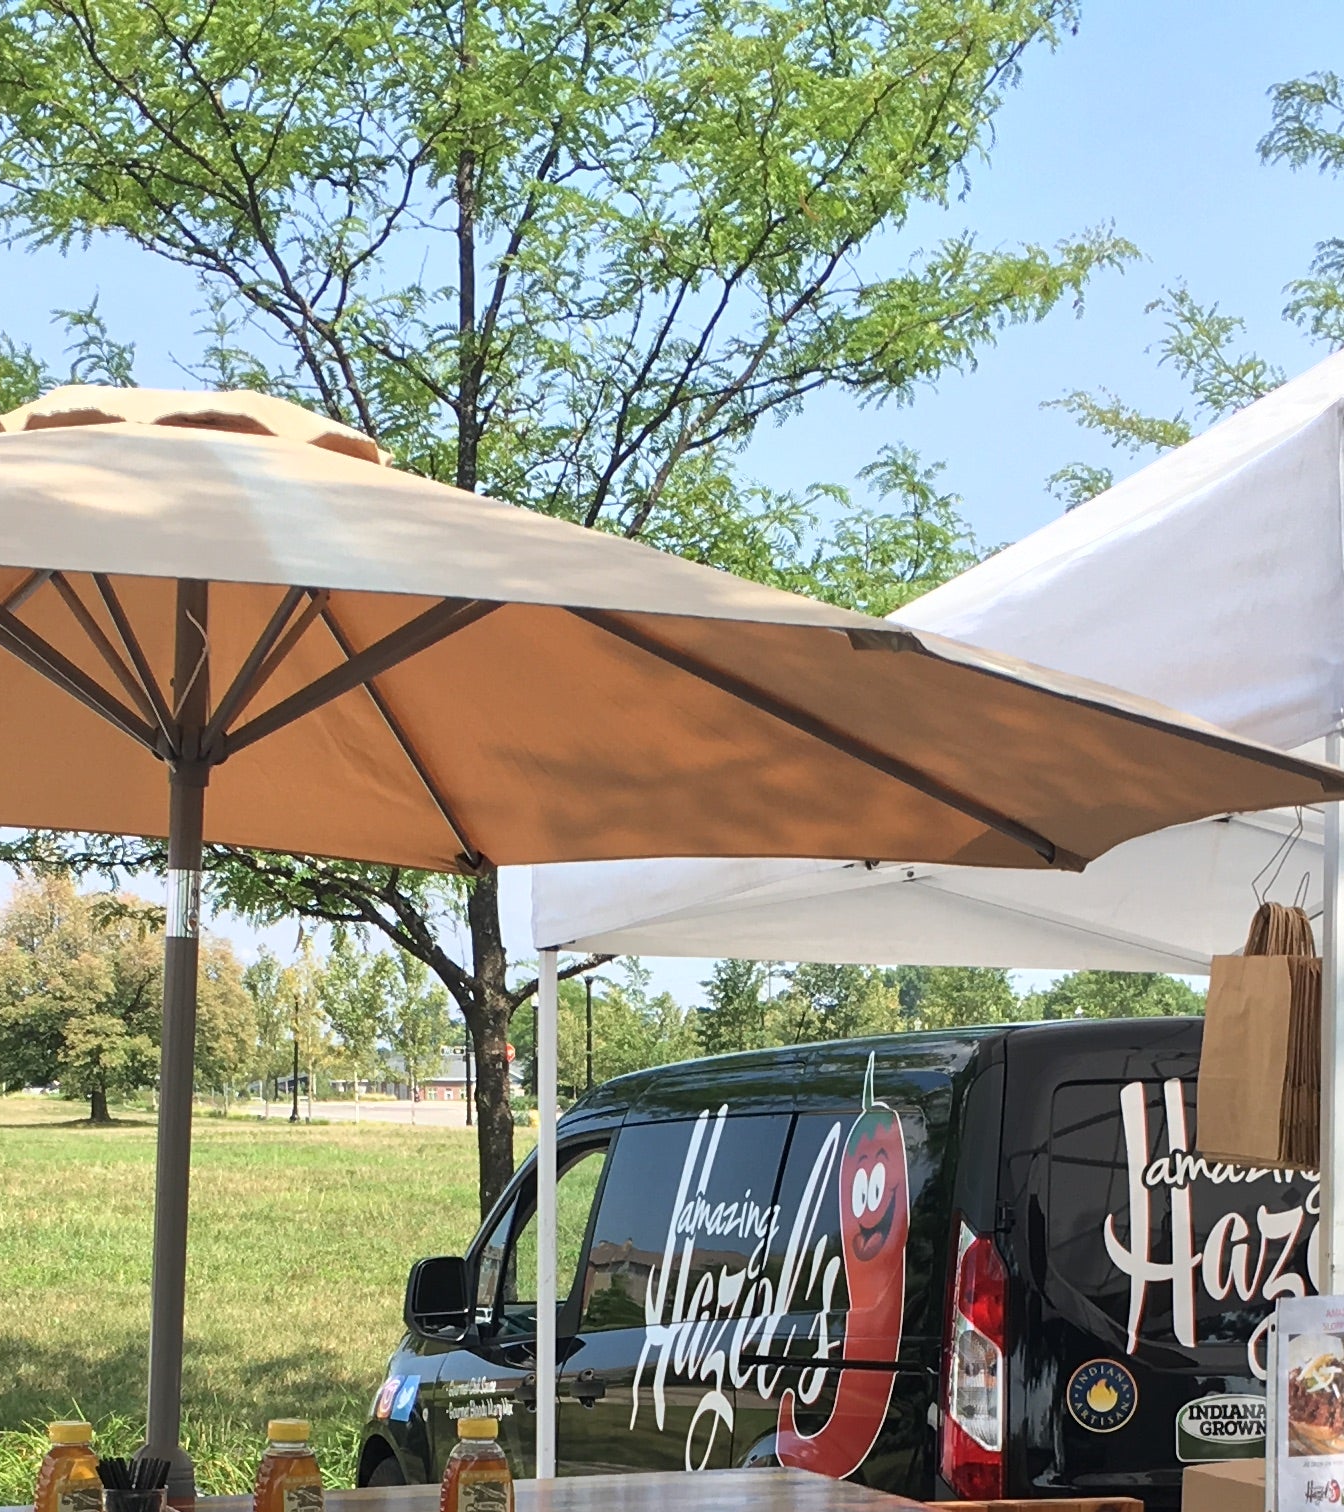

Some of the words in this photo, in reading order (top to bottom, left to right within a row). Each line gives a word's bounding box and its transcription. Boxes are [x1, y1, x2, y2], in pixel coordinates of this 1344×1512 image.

[629, 1103, 845, 1472] Hazel's
[1073, 1364, 1130, 1393] INDIANA
[1073, 1401, 1131, 1428] ARTISAN
[1188, 1403, 1266, 1420] INDIANA
[1199, 1420, 1266, 1436] GROWN
